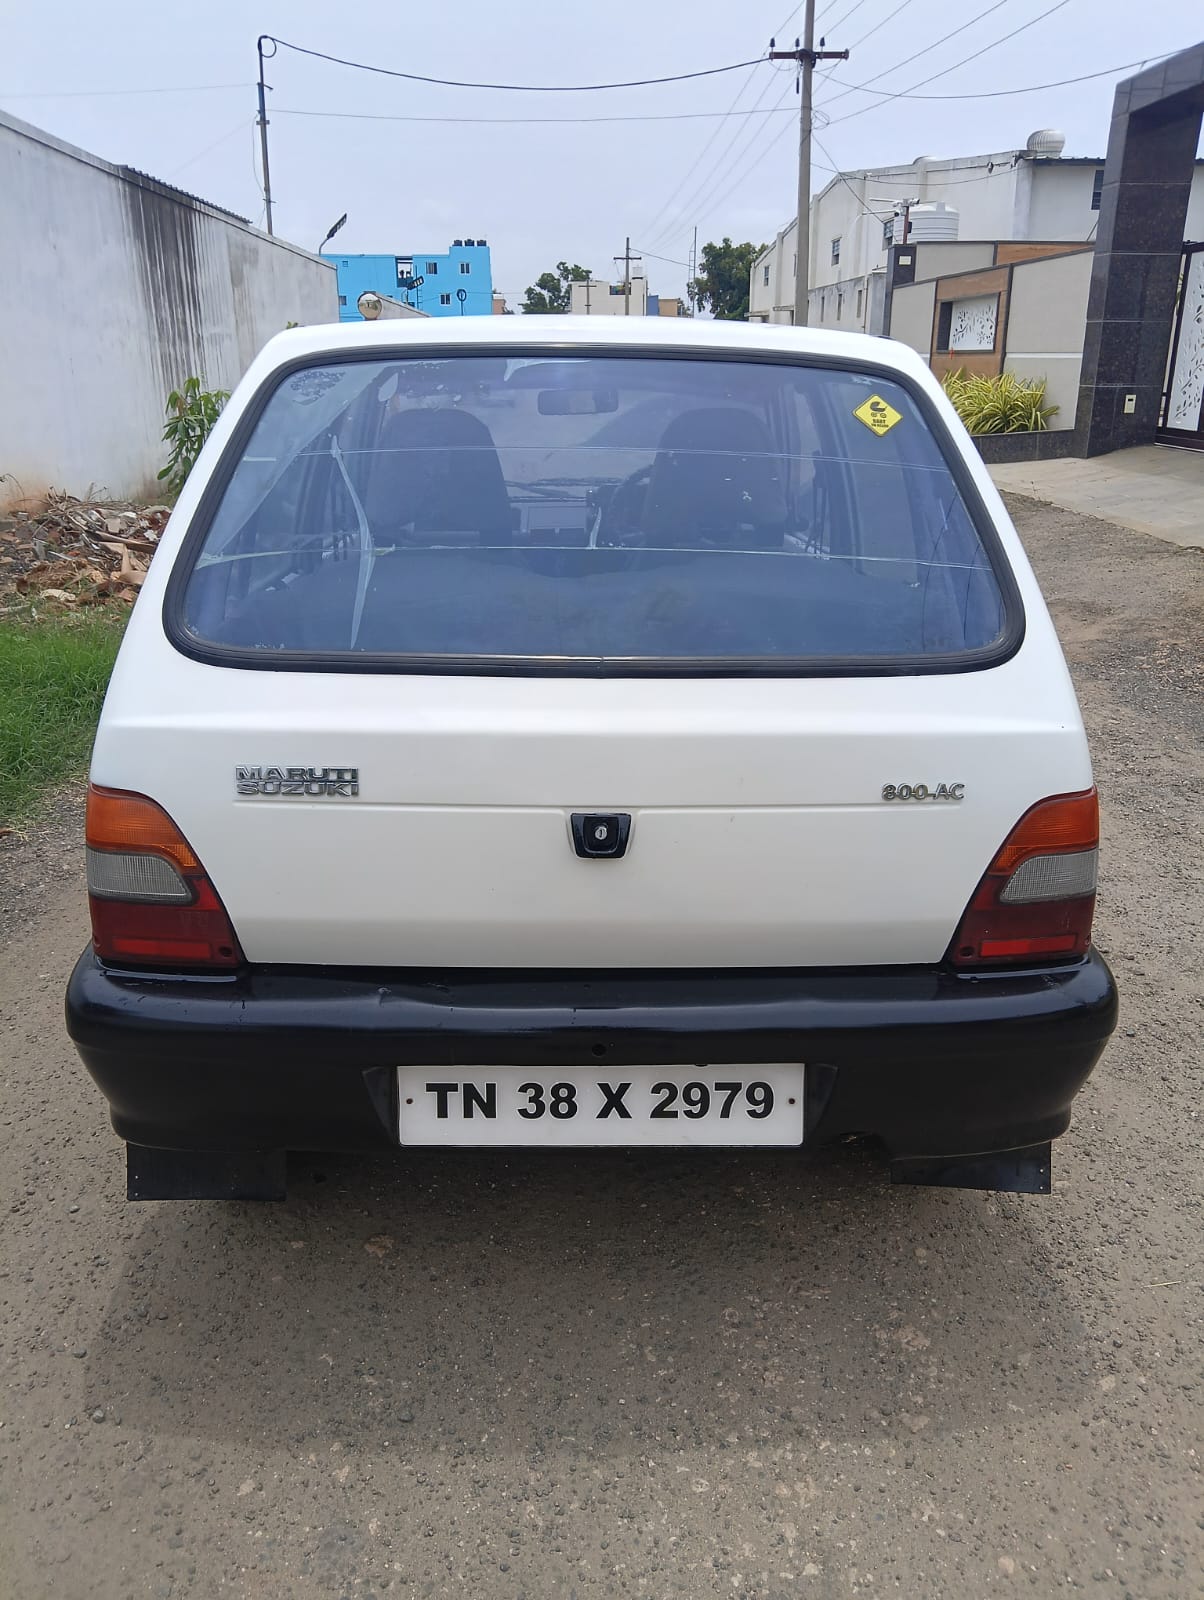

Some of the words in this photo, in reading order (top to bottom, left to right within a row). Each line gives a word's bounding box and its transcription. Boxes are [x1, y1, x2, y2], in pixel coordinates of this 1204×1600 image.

[235, 766, 359, 781] MARUTI
[236, 781, 359, 797] SUZUKI
[881, 782, 928, 801] 800
[932, 782, 965, 801] AC
[425, 1082, 497, 1119] TN
[517, 1082, 578, 1120] 38
[595, 1082, 633, 1119] X
[649, 1081, 775, 1120] 2979
